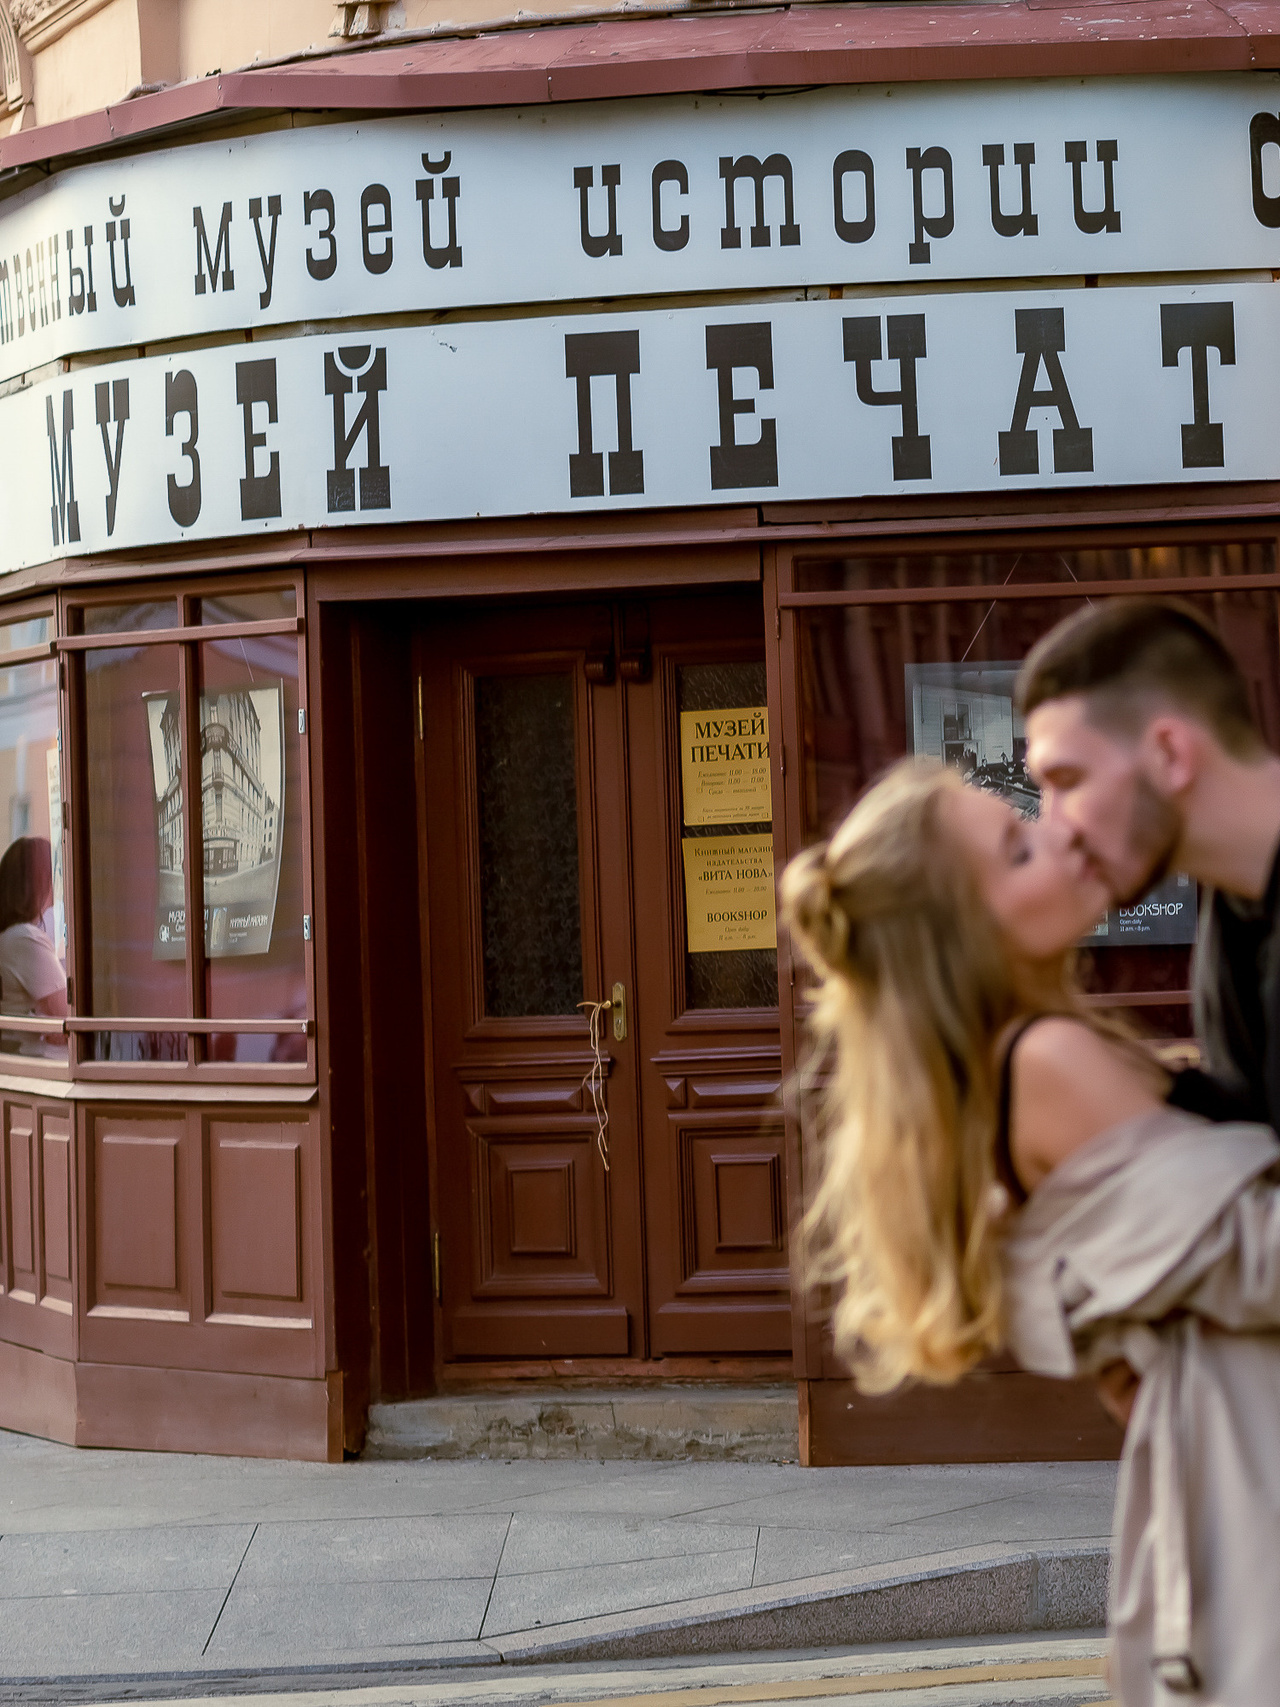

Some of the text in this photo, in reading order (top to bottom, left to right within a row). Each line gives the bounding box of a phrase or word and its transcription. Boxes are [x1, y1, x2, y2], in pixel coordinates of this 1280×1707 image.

[193, 150, 463, 310] музей
[573, 139, 1121, 265] истории
[45, 344, 393, 547] МУЗЕЙ
[695, 711, 765, 739] МУЗЕЙ
[691, 741, 770, 763] ПЕЧАТИ
[698, 869, 732, 881] «ВИТА
[707, 910, 768, 923] BOOKSHOP
